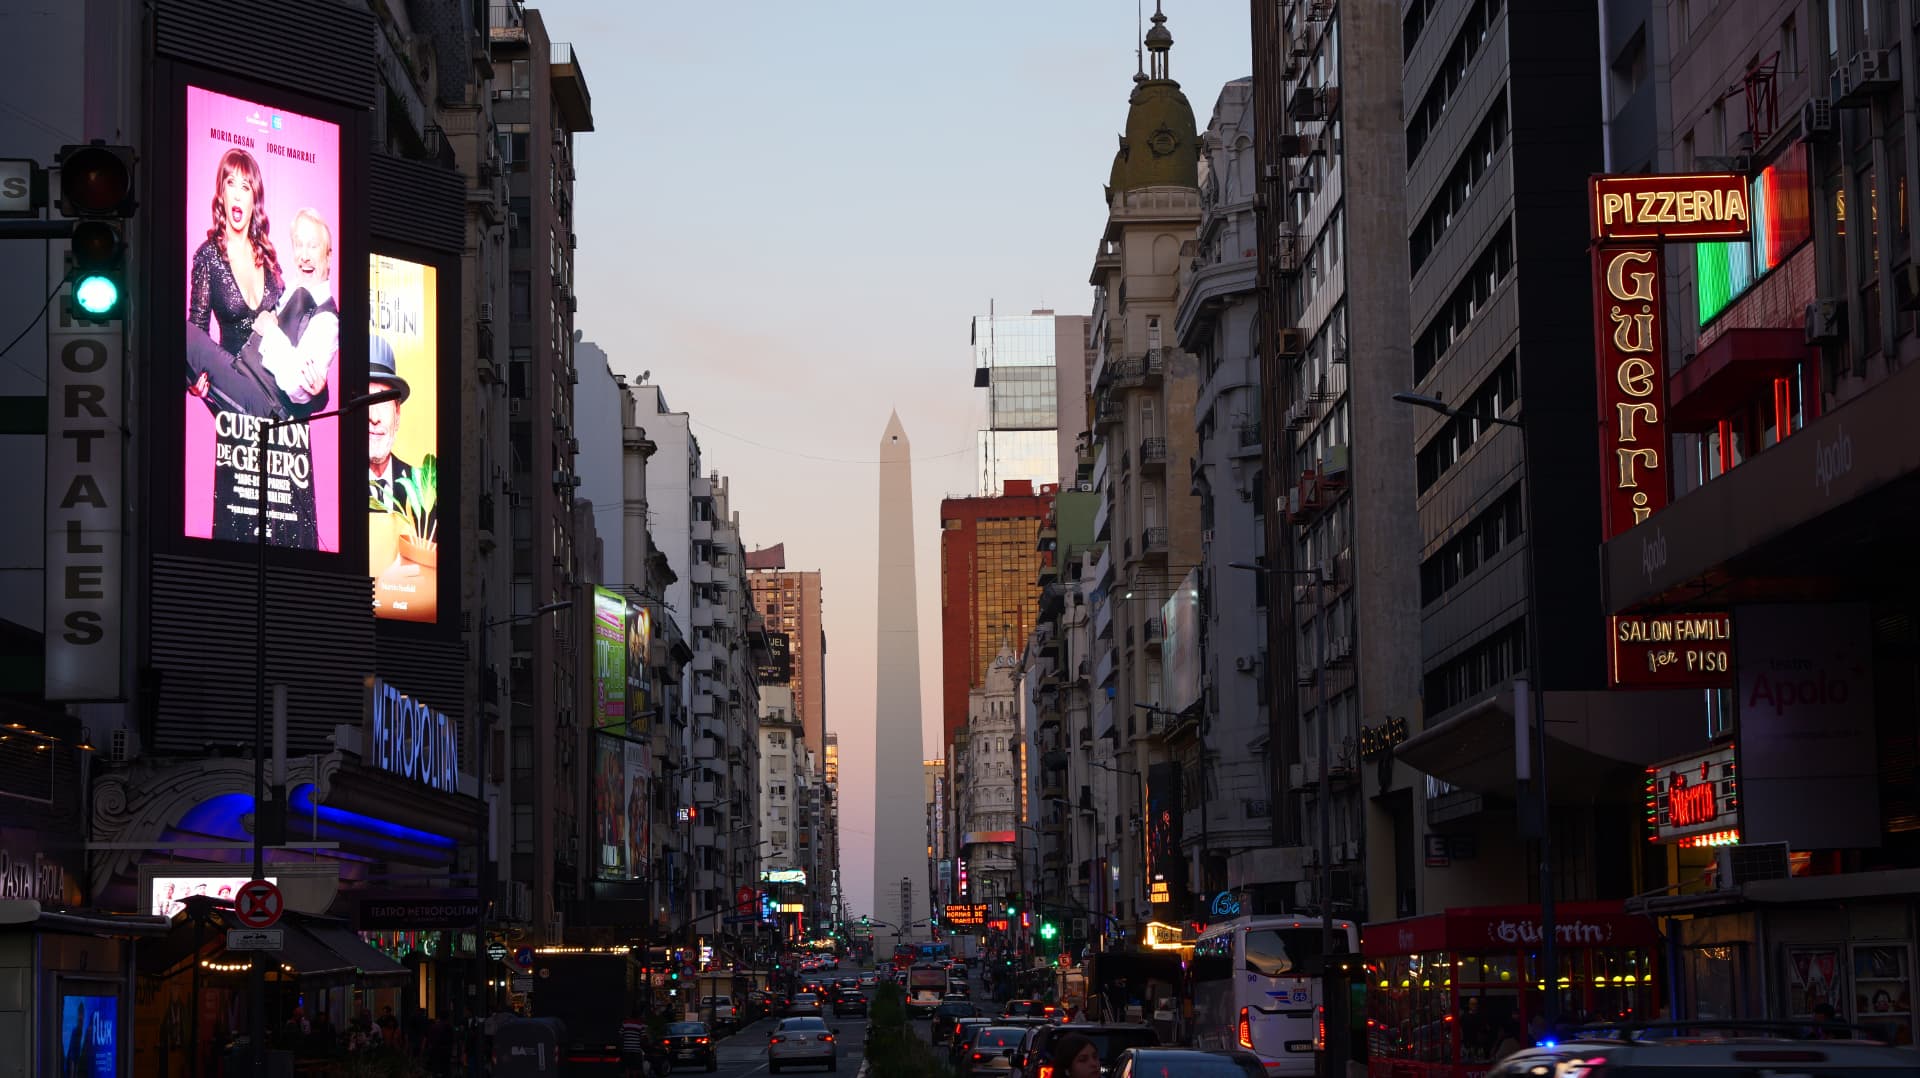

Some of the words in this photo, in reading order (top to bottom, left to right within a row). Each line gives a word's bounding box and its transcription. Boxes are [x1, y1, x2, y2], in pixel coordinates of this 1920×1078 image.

[210, 127, 231, 143] MORIA
[266, 142, 286, 157] JORGE
[286, 147, 316, 164] MARRALE
[1603, 189, 1746, 225] PIZZERIA
[215, 410, 310, 450] CUESTIÓN
[216, 442, 232, 467] DE
[1815, 424, 1853, 497] Apolo
[1641, 528, 1667, 585] Apolo
[1619, 620, 1672, 641] SALON
[1685, 650, 1728, 672] PISO
[1748, 671, 1849, 717] Apolo
[372, 677, 459, 793] METROPOLITAN
[0, 848, 32, 899] PASTA
[34, 852, 65, 902] FROLA
[370, 904, 405, 917] TEATRO
[407, 903, 480, 917] METROPOLITAN
